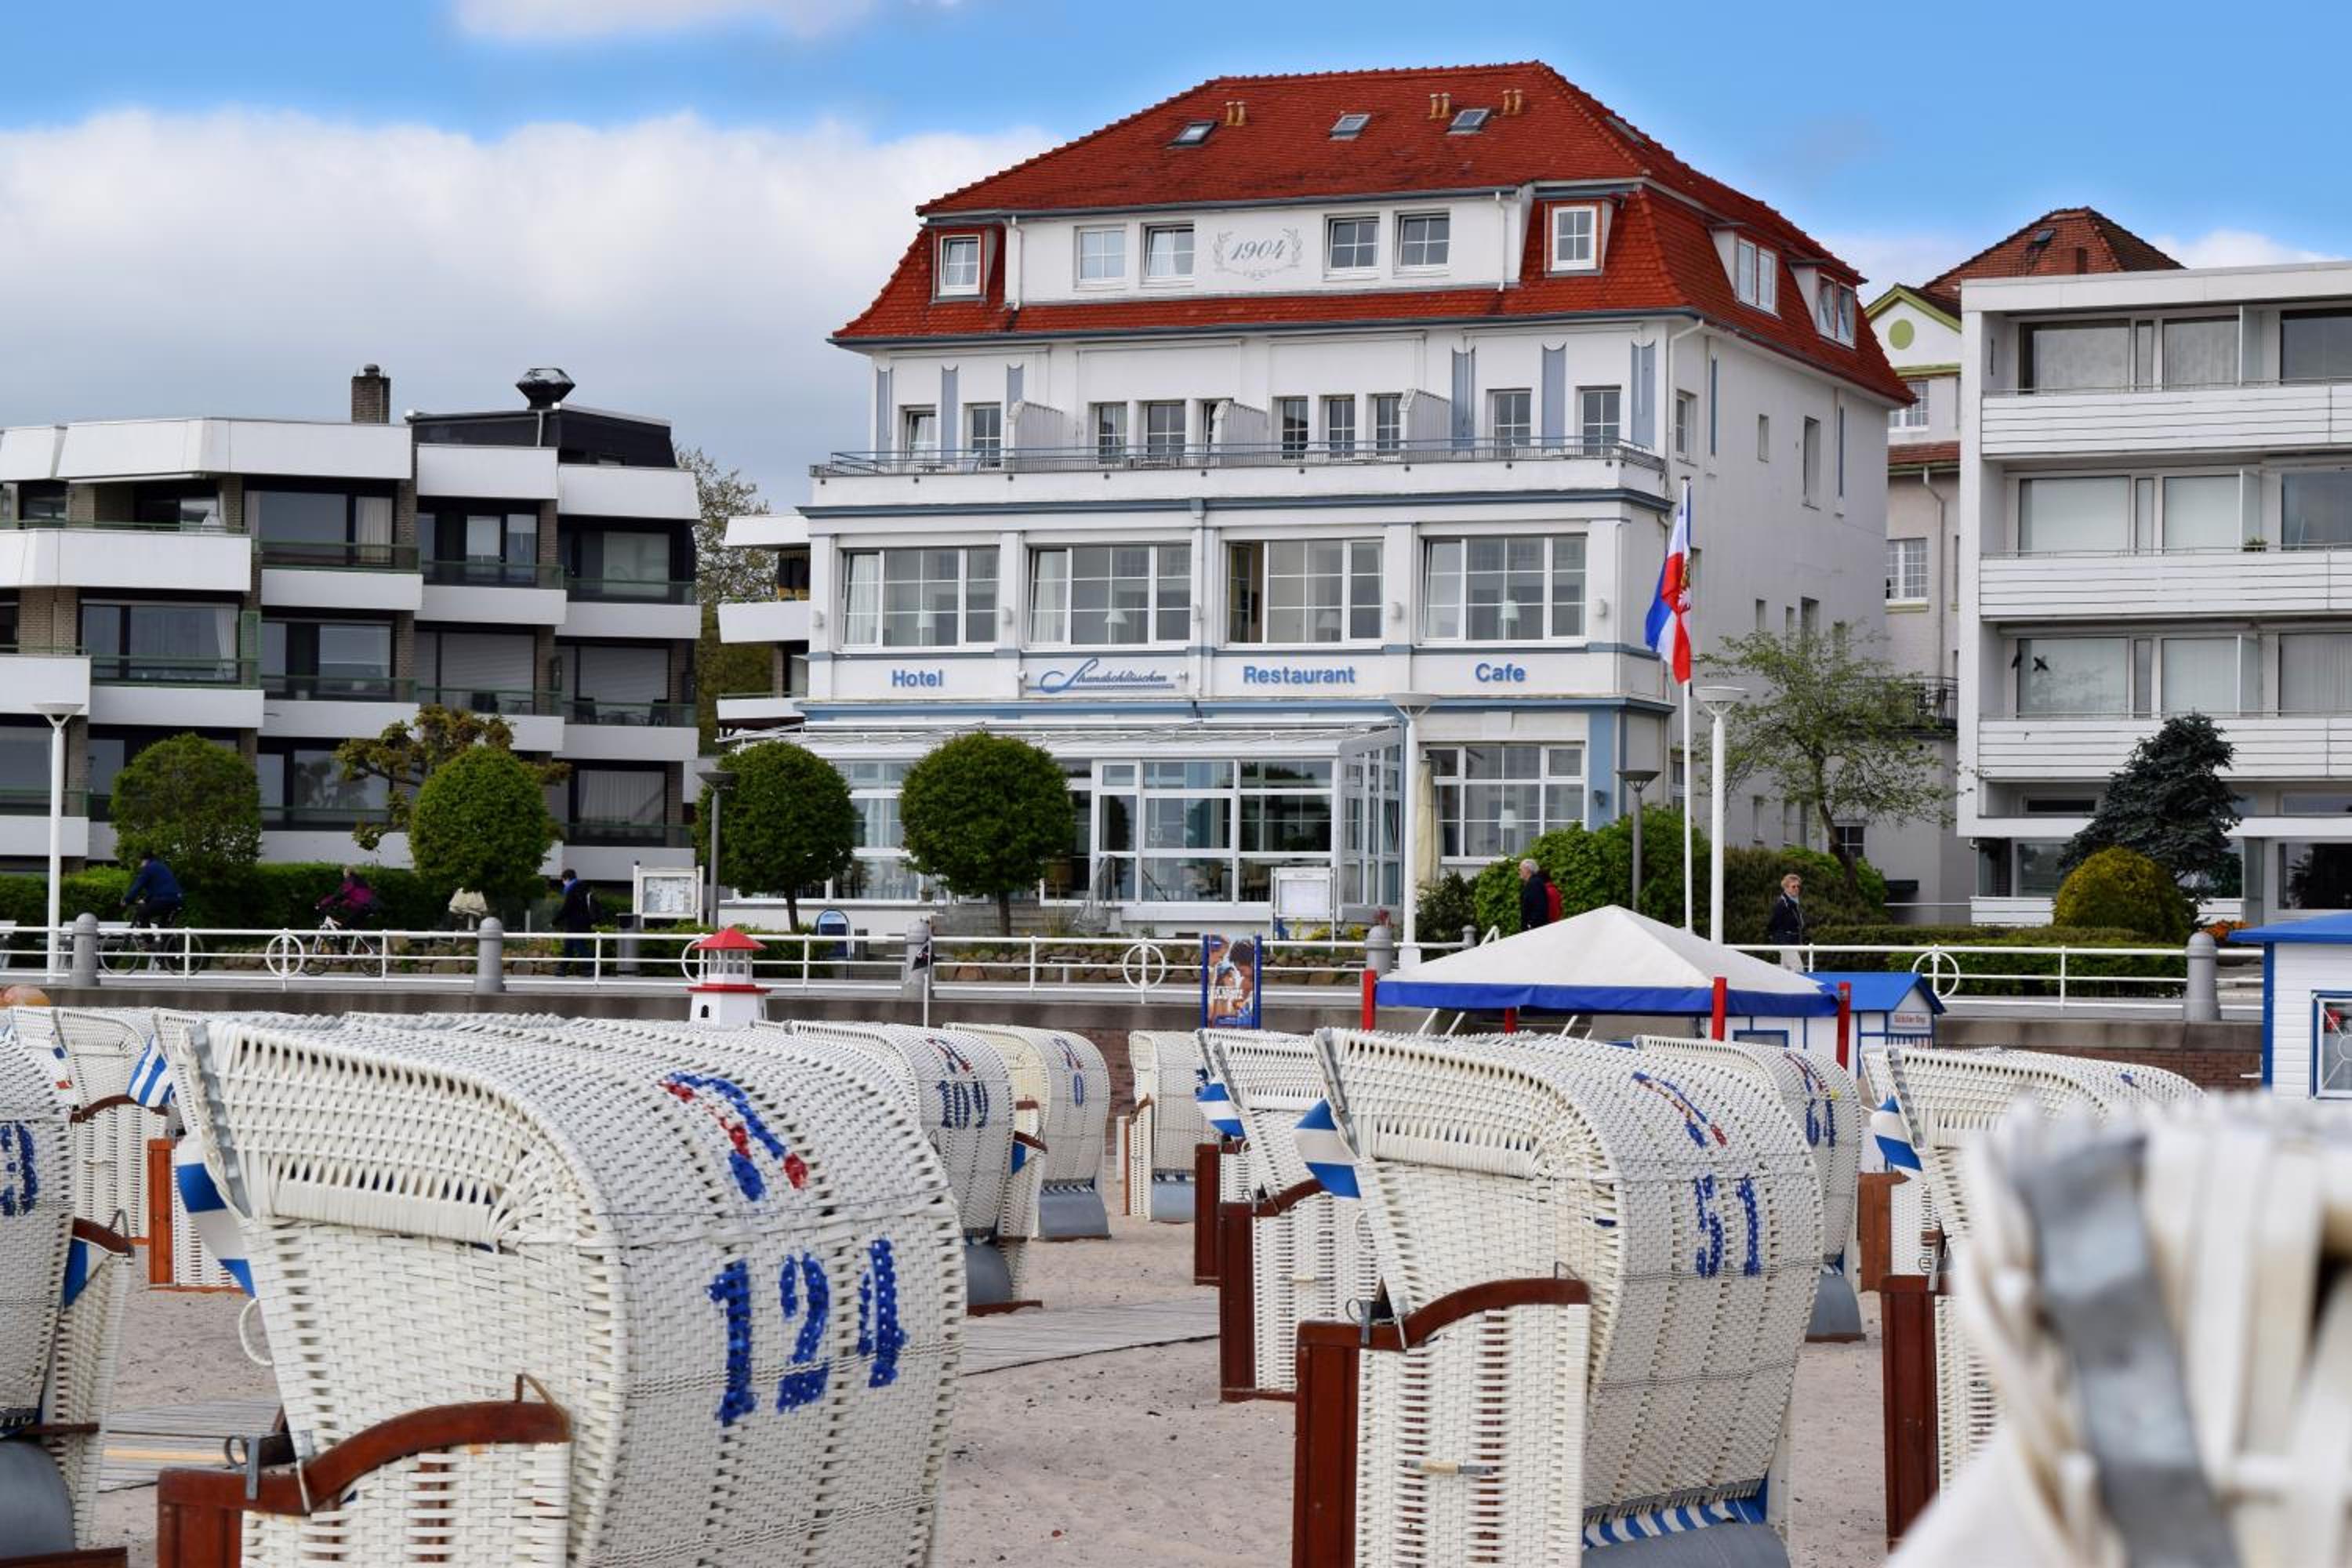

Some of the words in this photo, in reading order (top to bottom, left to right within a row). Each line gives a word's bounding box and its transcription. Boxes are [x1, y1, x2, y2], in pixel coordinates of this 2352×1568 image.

[1230, 239, 1287, 261] 1904
[892, 669, 944, 688] Hotel
[1243, 665, 1356, 684] Restaurant
[1475, 662, 1526, 682] Cafe
[1694, 1173, 1762, 1278] 51
